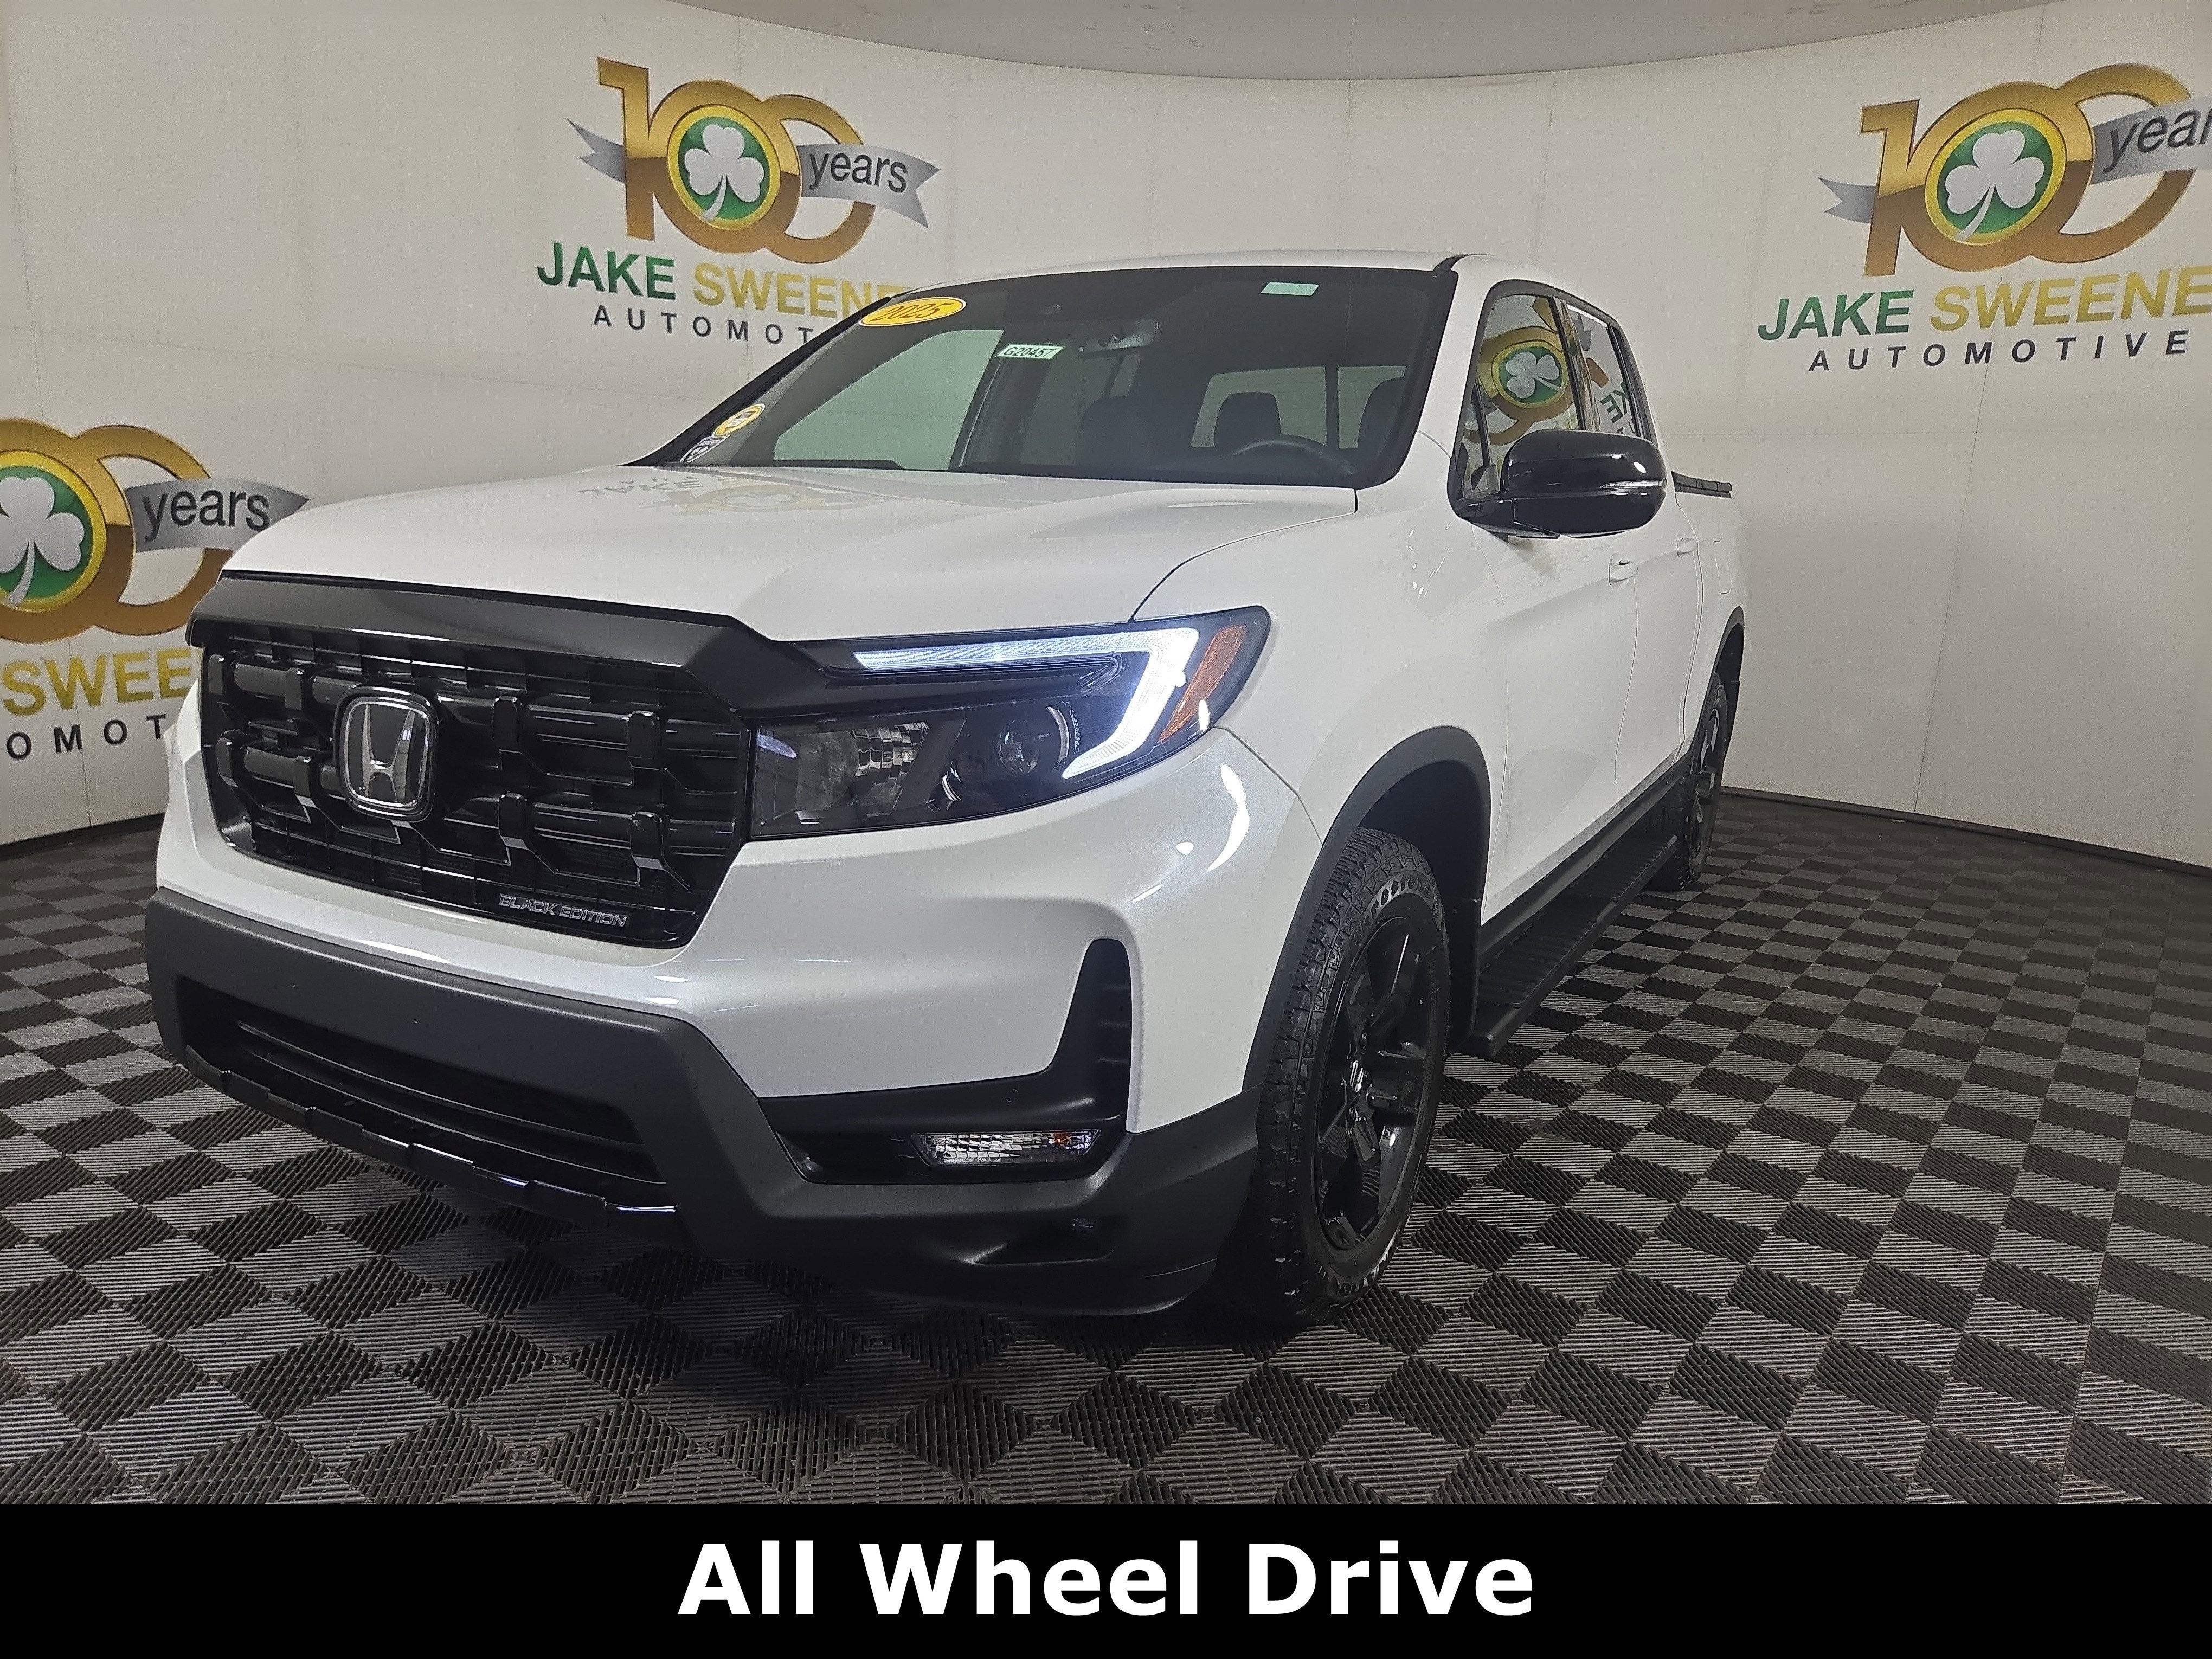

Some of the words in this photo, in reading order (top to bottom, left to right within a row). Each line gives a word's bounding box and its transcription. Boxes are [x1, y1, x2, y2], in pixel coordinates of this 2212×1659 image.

[808, 152, 909, 194] years
[537, 241, 677, 301] JAKE
[693, 262, 916, 319] SWEEN
[869, 303, 955, 322] 2025
[1758, 289, 1914, 341] JAKE
[1004, 346, 1056, 358] G20457
[1809, 329, 2190, 372] AUTOMOTIVE
[142, 488, 271, 543] years
[499, 894, 558, 915] BLACK
[558, 905, 628, 927] EDITION
